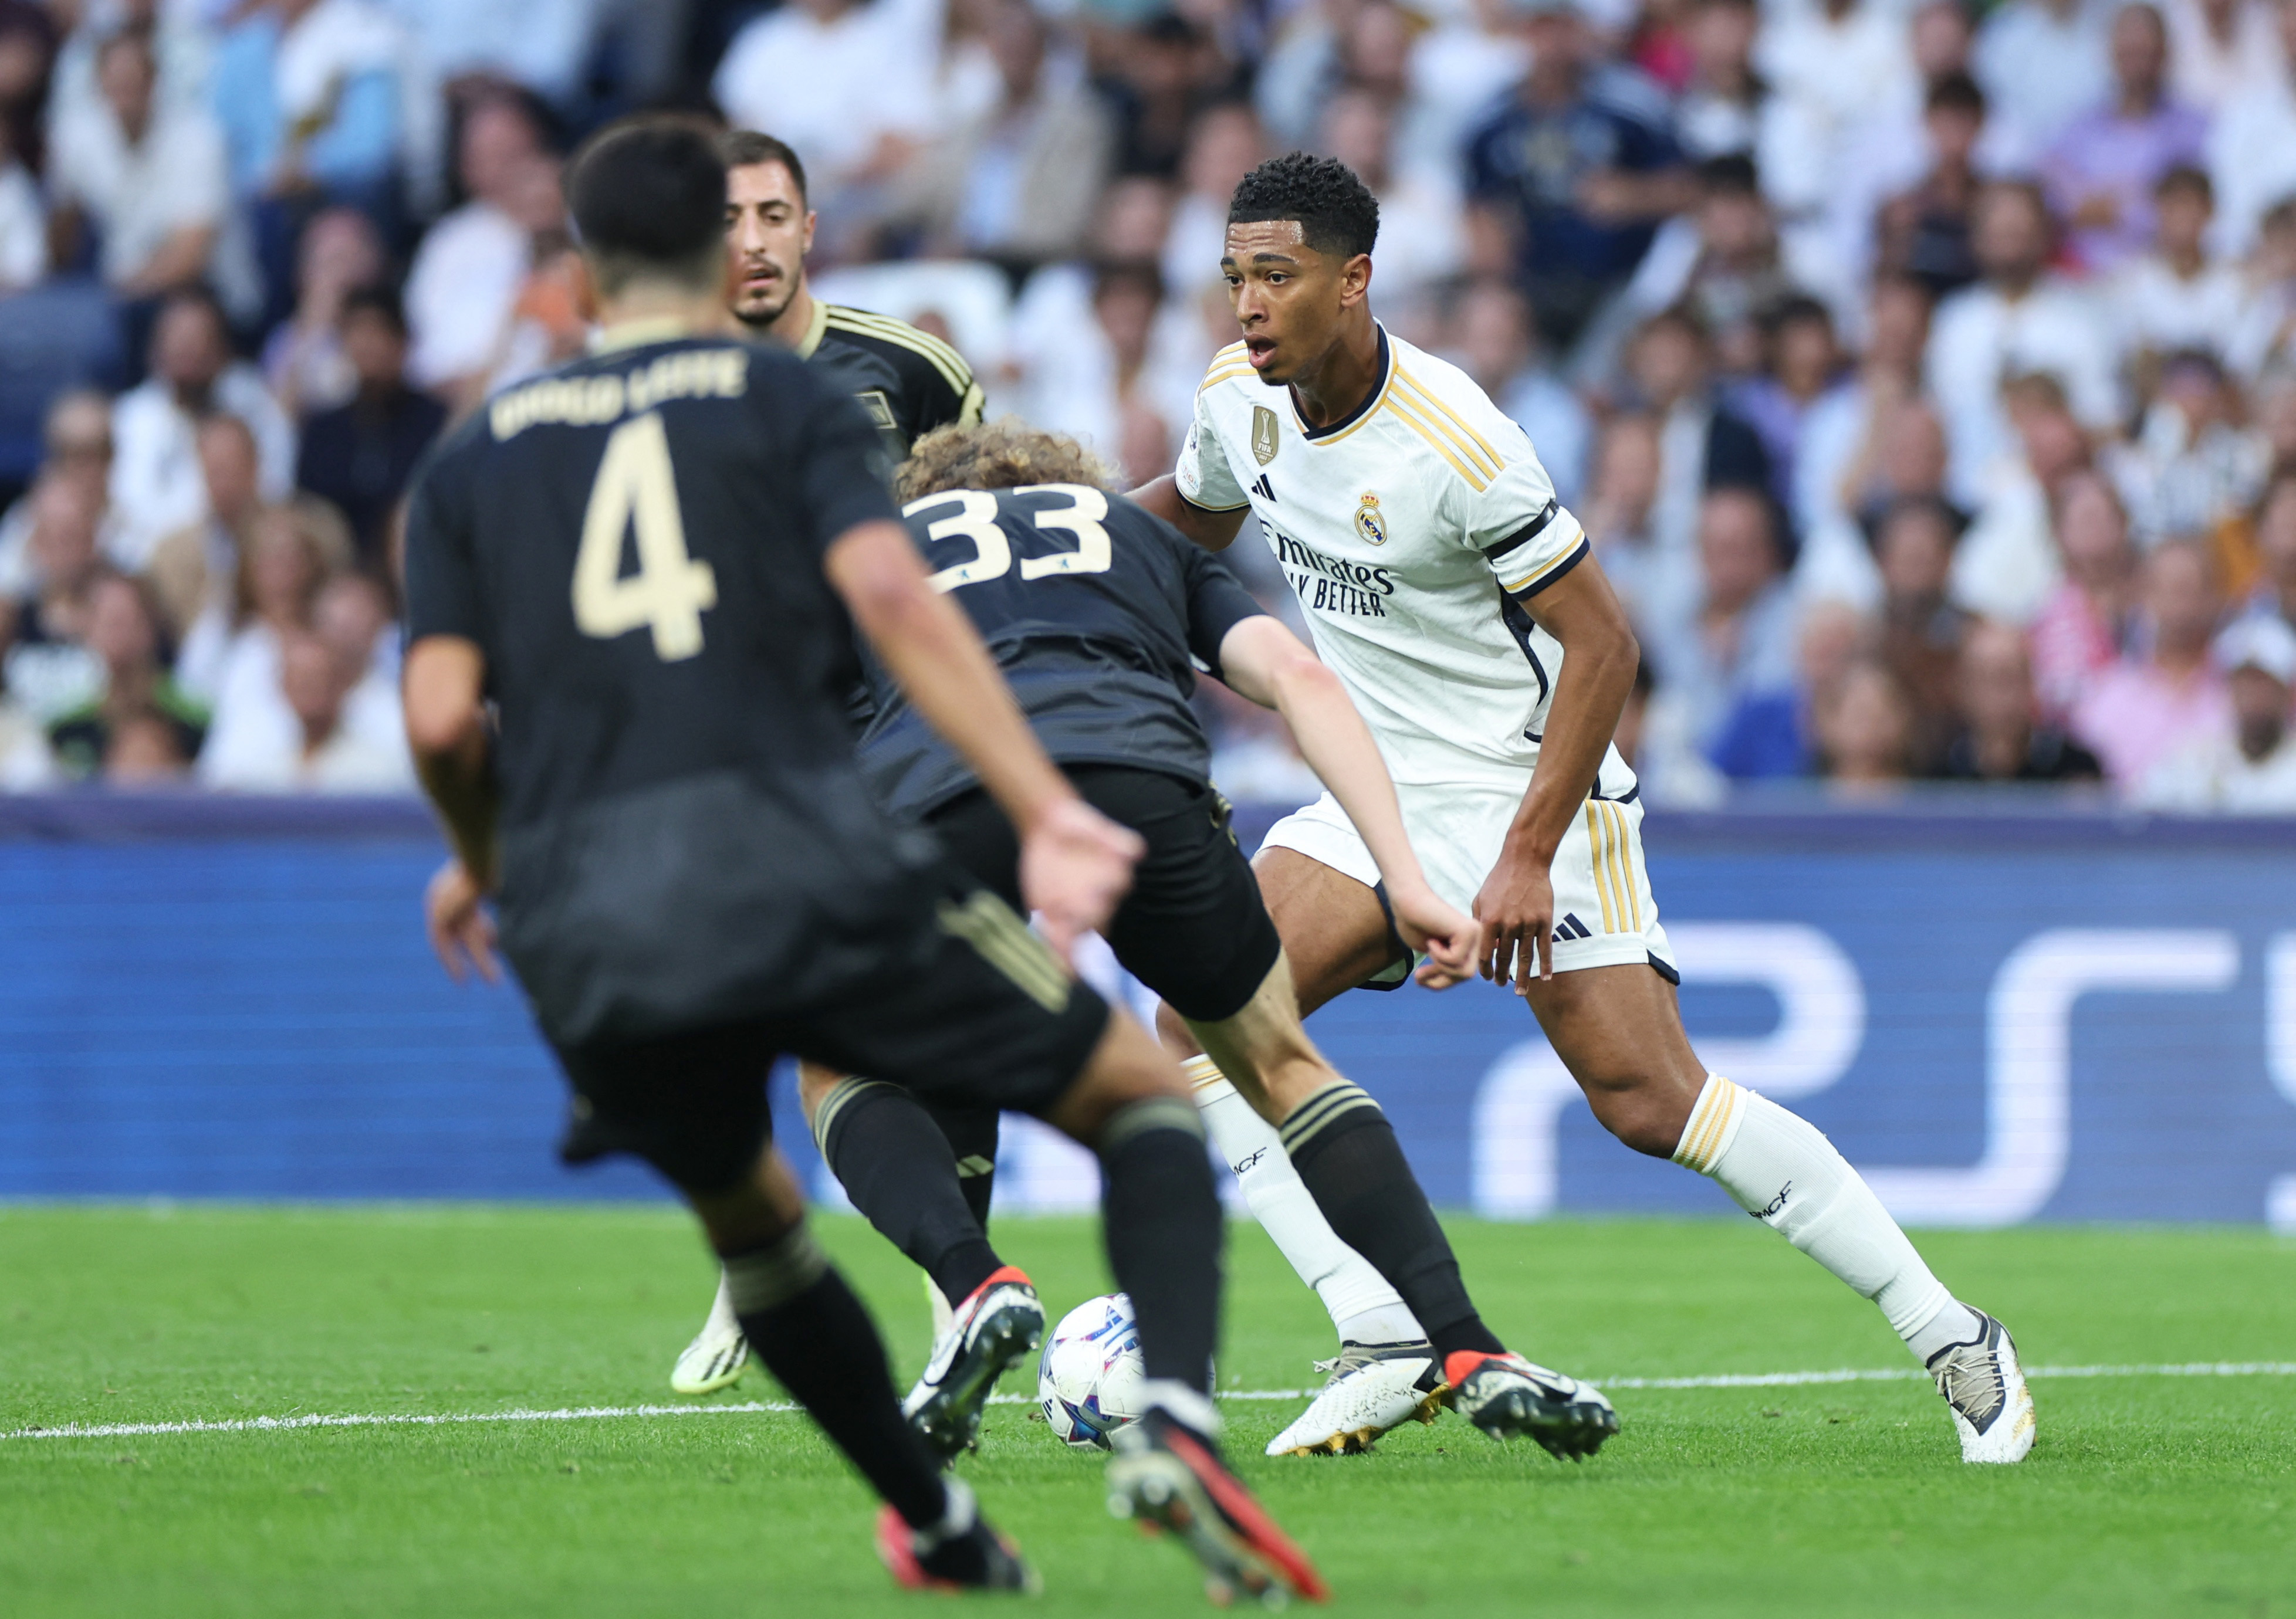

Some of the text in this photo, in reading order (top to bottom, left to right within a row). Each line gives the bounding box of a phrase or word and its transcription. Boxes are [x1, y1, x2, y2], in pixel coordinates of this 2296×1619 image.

[1257, 442, 1272, 454] FIFA
[570, 411, 719, 663] 4
[901, 482, 1113, 595] 33
[1313, 578, 1387, 618] BETTER
[1470, 923, 2296, 1238] PS
